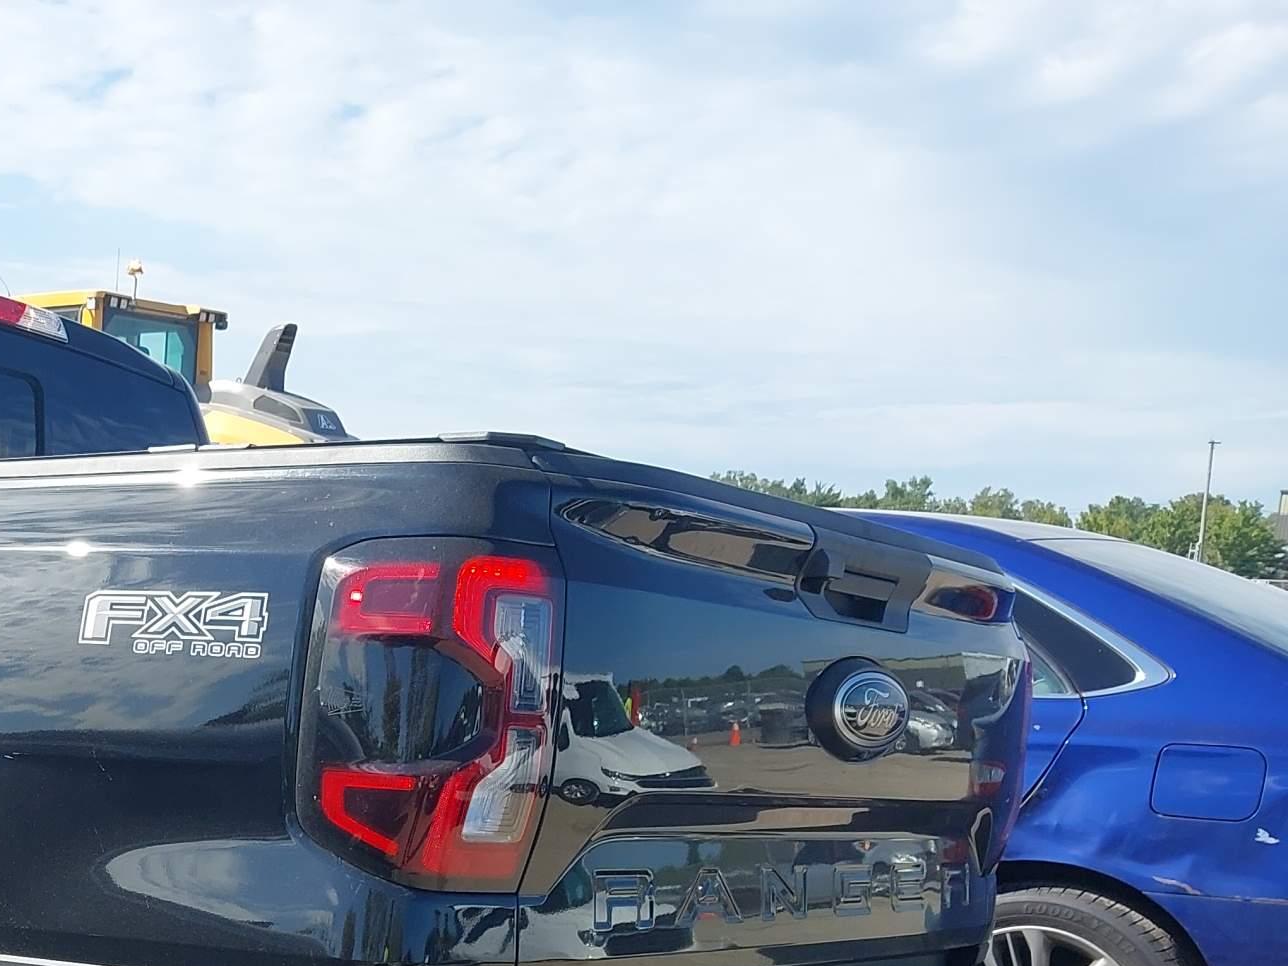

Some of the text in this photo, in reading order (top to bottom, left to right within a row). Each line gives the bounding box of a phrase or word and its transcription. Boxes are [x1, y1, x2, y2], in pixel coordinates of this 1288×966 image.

[78, 589, 269, 645] FX4
[132, 639, 262, 659] OFF ROAD
[857, 687, 899, 729] Ford
[592, 863, 970, 931] RANGER
